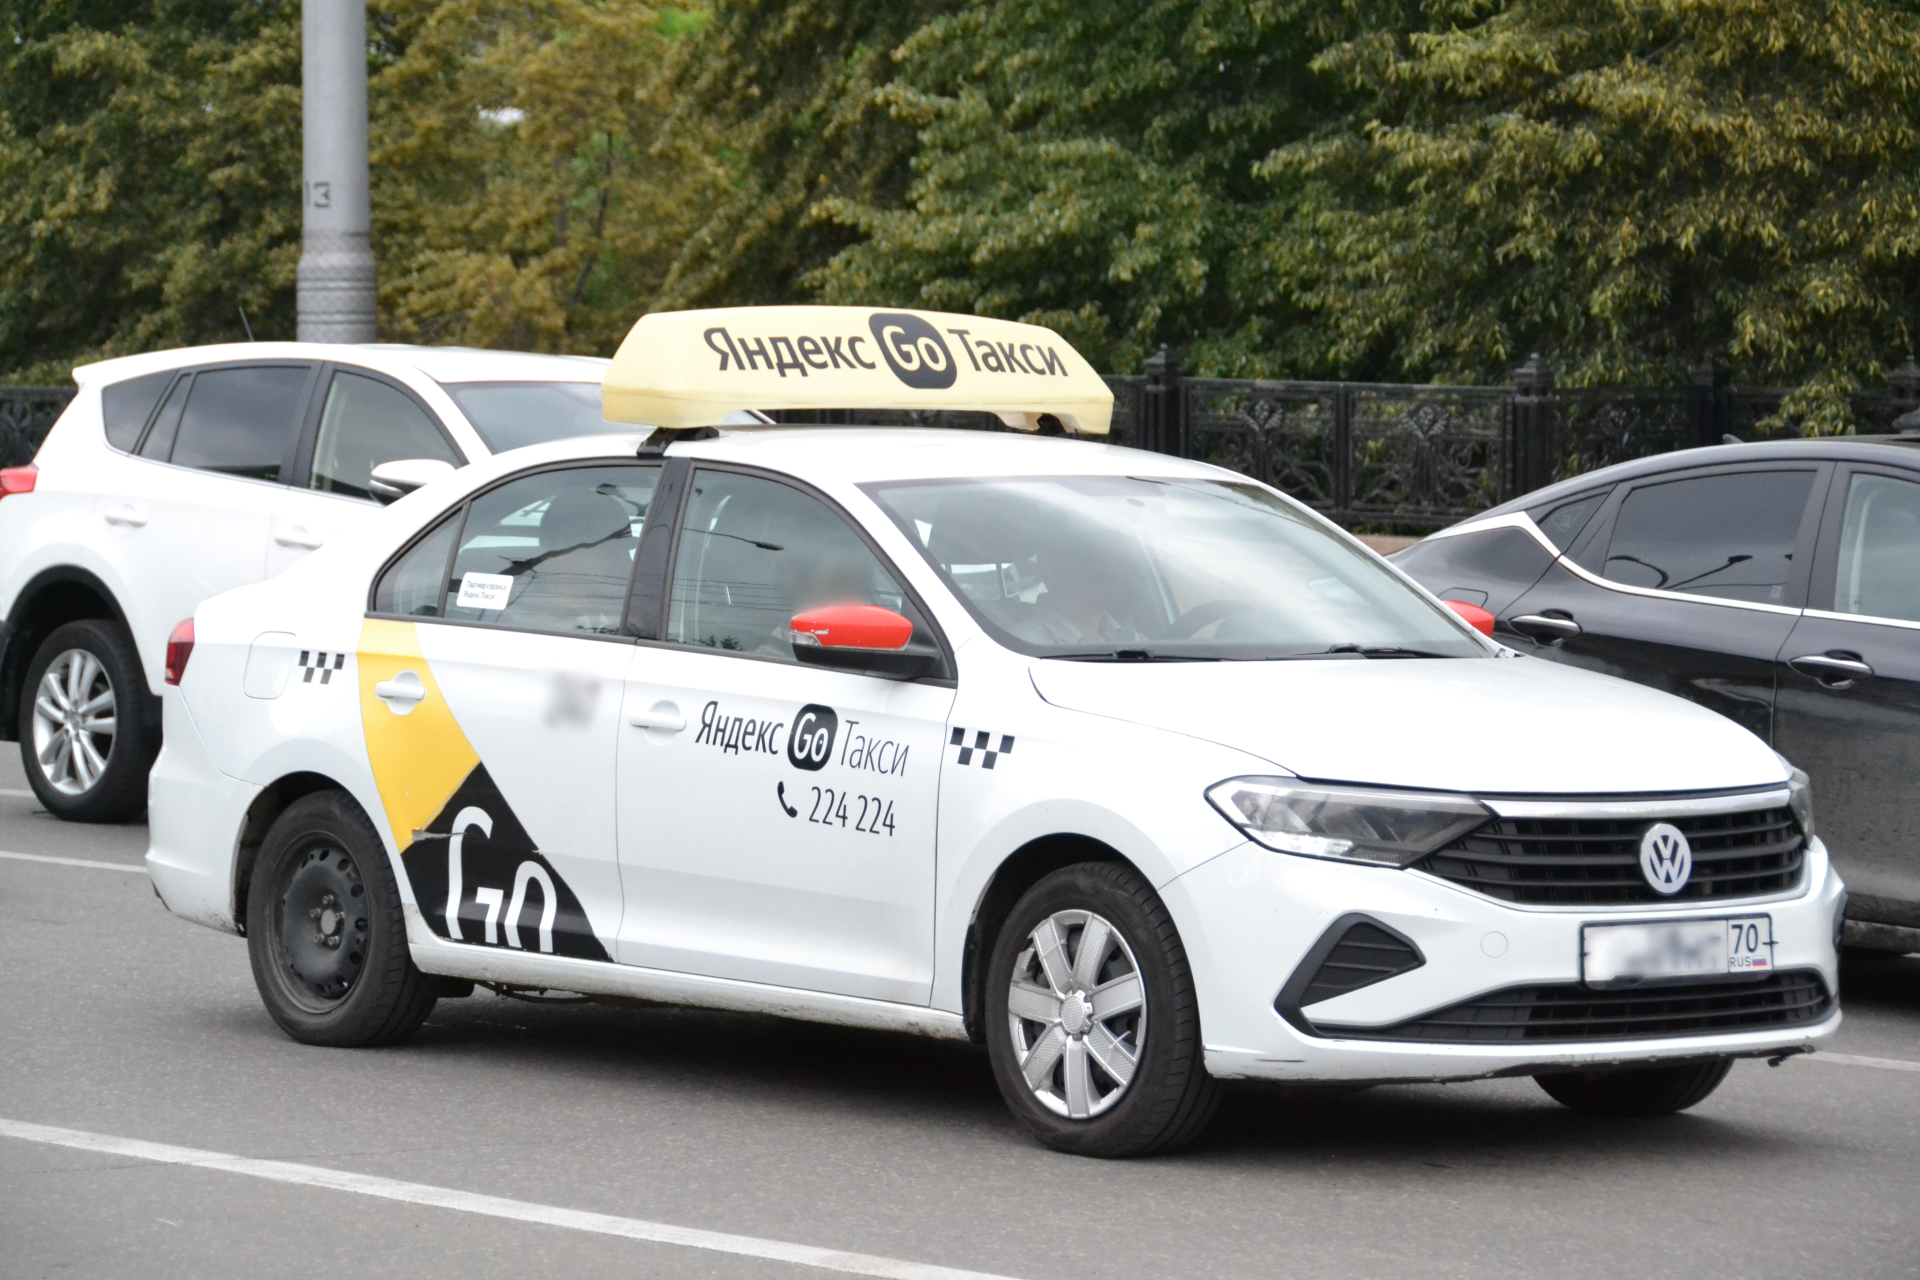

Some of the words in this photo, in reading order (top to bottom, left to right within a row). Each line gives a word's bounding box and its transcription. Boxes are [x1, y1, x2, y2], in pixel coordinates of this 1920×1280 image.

[703, 327, 875, 377] Яндекс
[882, 324, 947, 372] Go
[947, 328, 1068, 377] Такси
[695, 700, 784, 755] Яндекс
[793, 712, 829, 762] Go
[840, 719, 910, 777] Такси
[808, 786, 849, 828] 224
[855, 795, 896, 837] 224
[1729, 956, 1751, 968] RUS
[1731, 923, 1758, 954] 70
